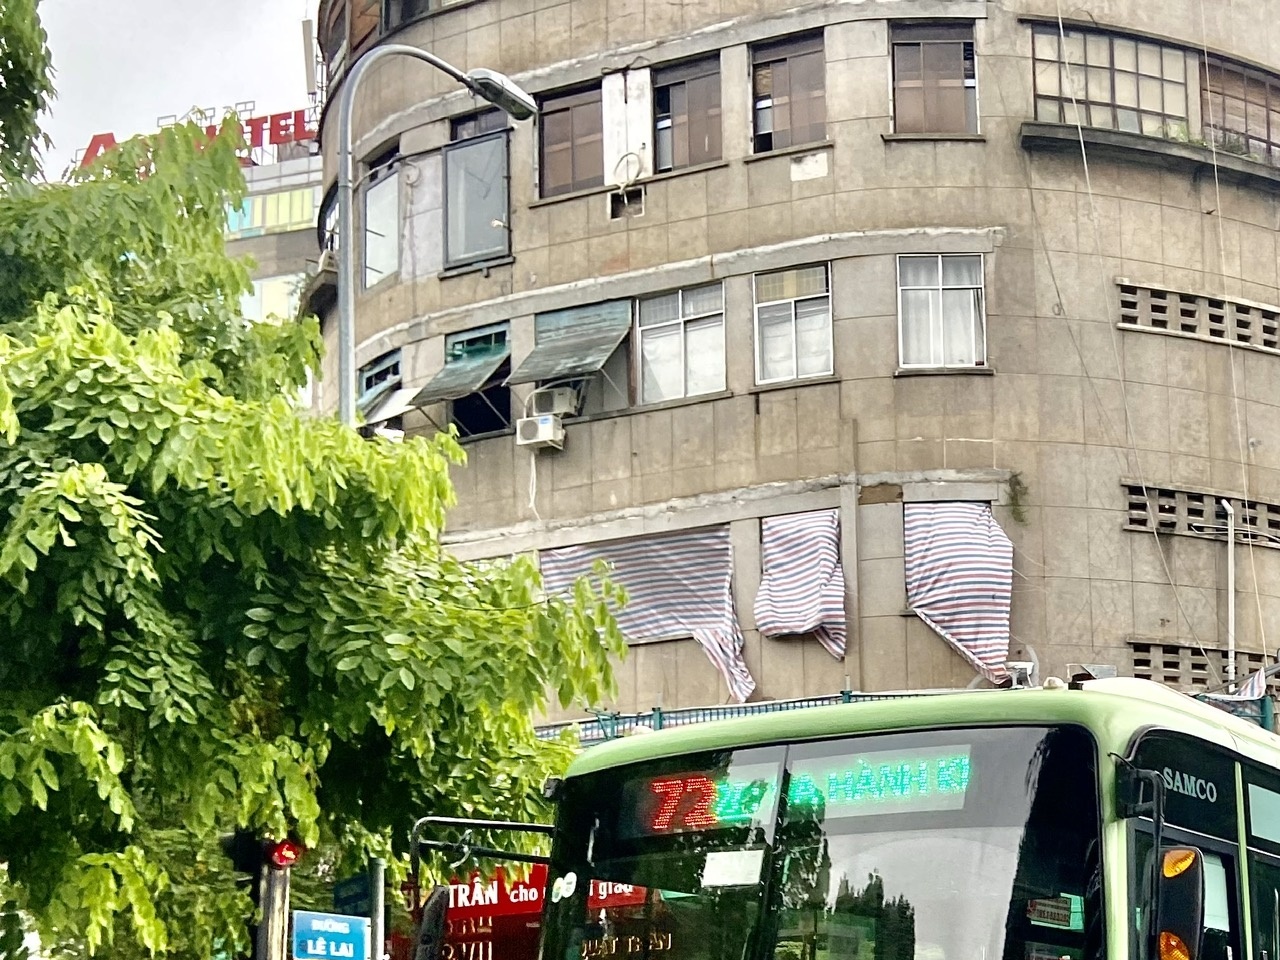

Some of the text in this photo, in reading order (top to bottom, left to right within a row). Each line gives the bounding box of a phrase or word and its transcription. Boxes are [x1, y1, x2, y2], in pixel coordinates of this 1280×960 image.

[828, 759, 928, 803] HÀNH
[1162, 766, 1218, 803] SAMCO
[651, 776, 718, 830] 72
[509, 884, 539, 903] cho
[306, 936, 354, 958] LÊ LAI
